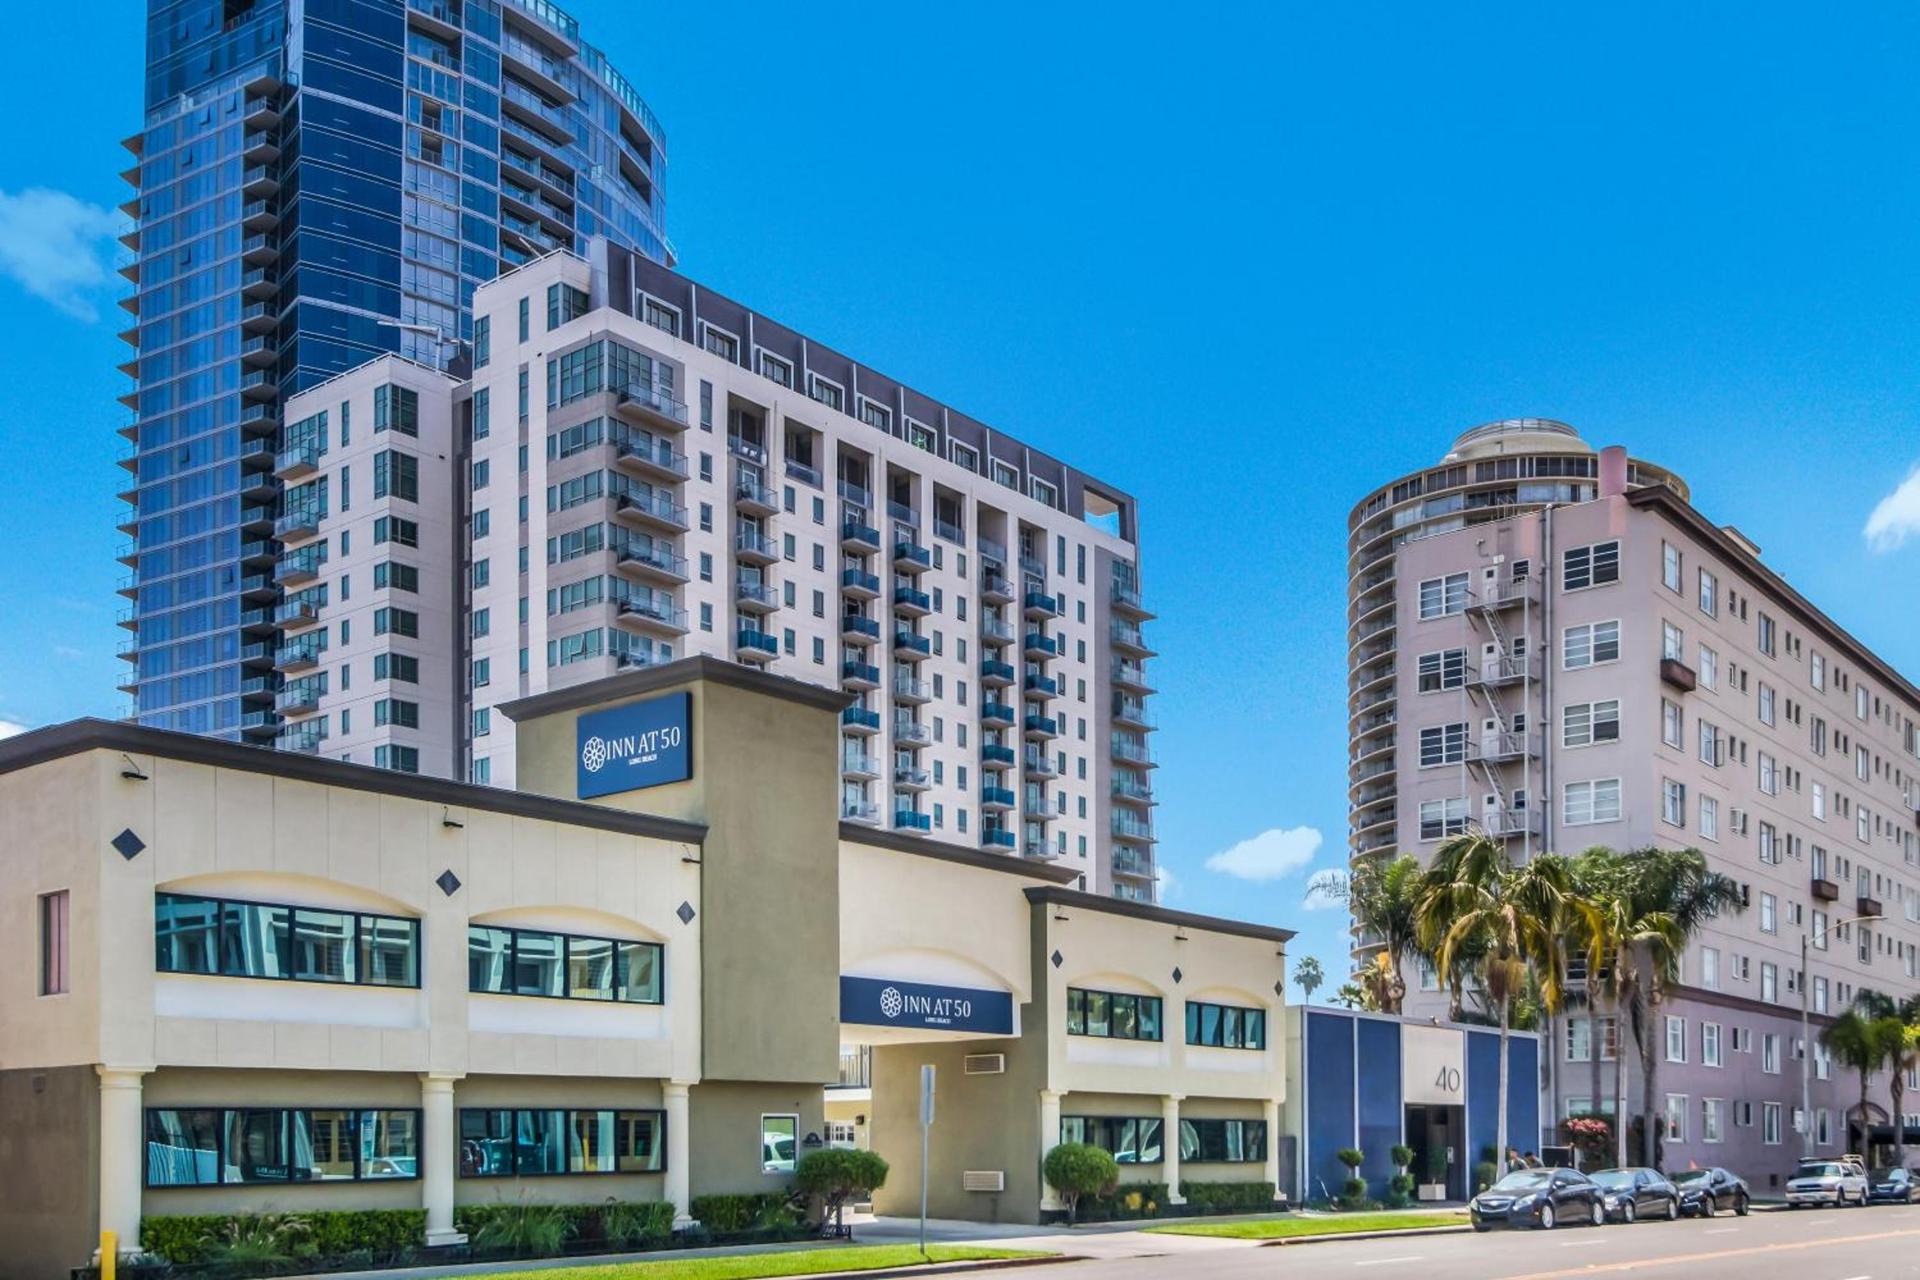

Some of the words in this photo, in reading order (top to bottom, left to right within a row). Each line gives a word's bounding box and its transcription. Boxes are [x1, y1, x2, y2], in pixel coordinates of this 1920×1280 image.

[606, 736, 635, 760] INN
[638, 730, 659, 754] AT
[661, 726, 681, 749] 50
[904, 995, 931, 1014] INN
[934, 998, 952, 1016] AT
[954, 1000, 971, 1017] 50
[1435, 1065, 1460, 1092] 40
